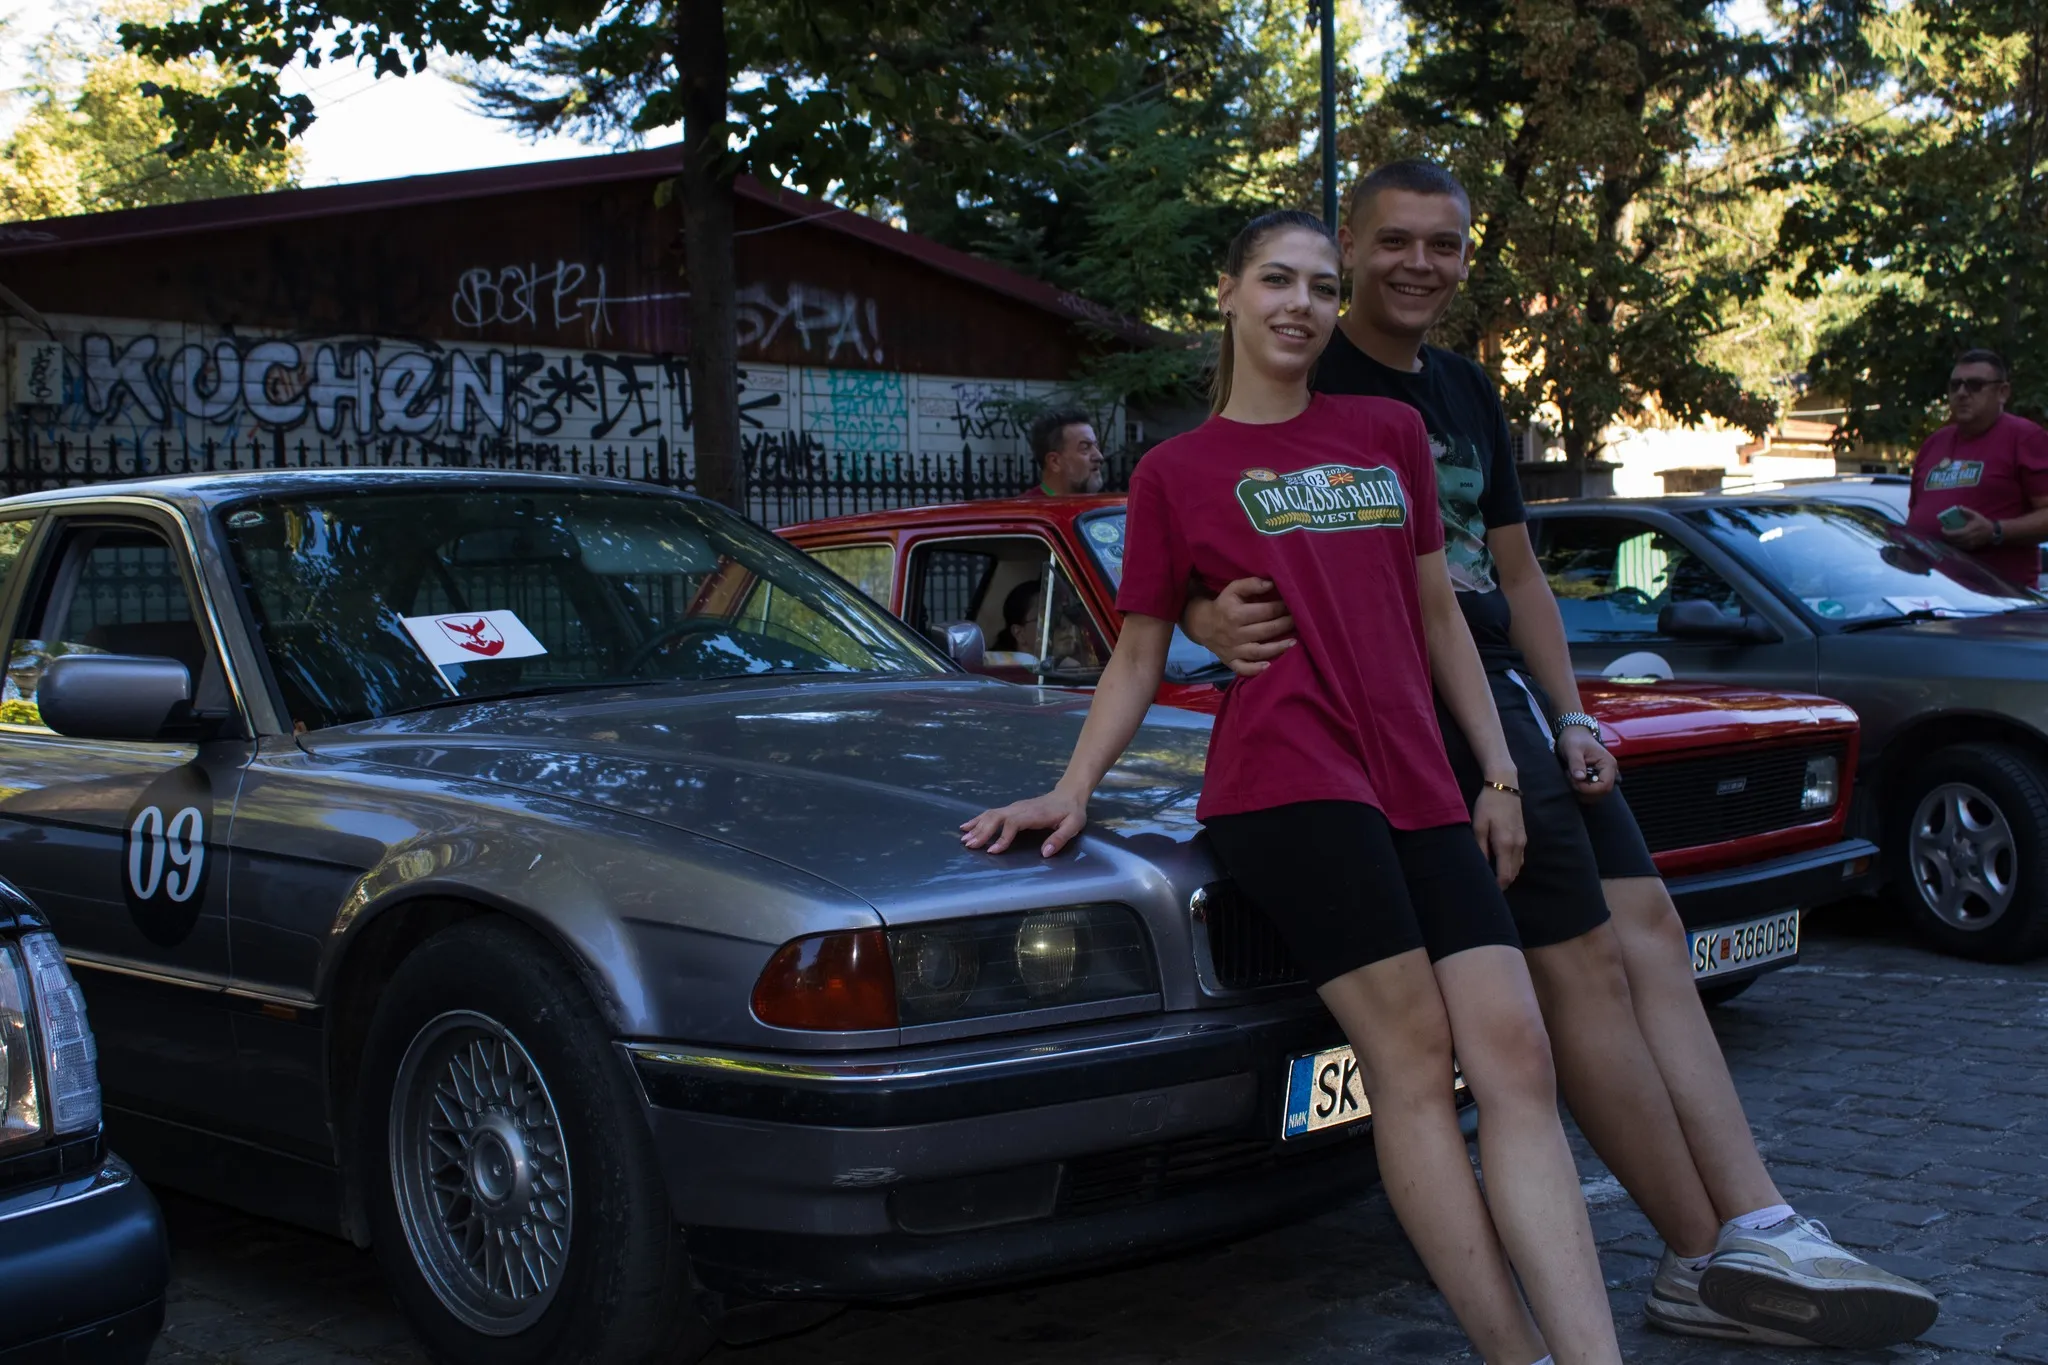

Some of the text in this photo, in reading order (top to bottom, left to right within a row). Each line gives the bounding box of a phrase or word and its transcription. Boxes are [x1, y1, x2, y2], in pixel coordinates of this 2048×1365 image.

[1254, 480, 1399, 515] VM CLASSIC RALLY
[1307, 473, 1326, 487] 03
[1311, 511, 1357, 525] WEST
[128, 805, 206, 903] 09
[1693, 933, 1719, 972] SK
[1315, 1056, 1359, 1119] SK
[1288, 1110, 1308, 1130] NMK
